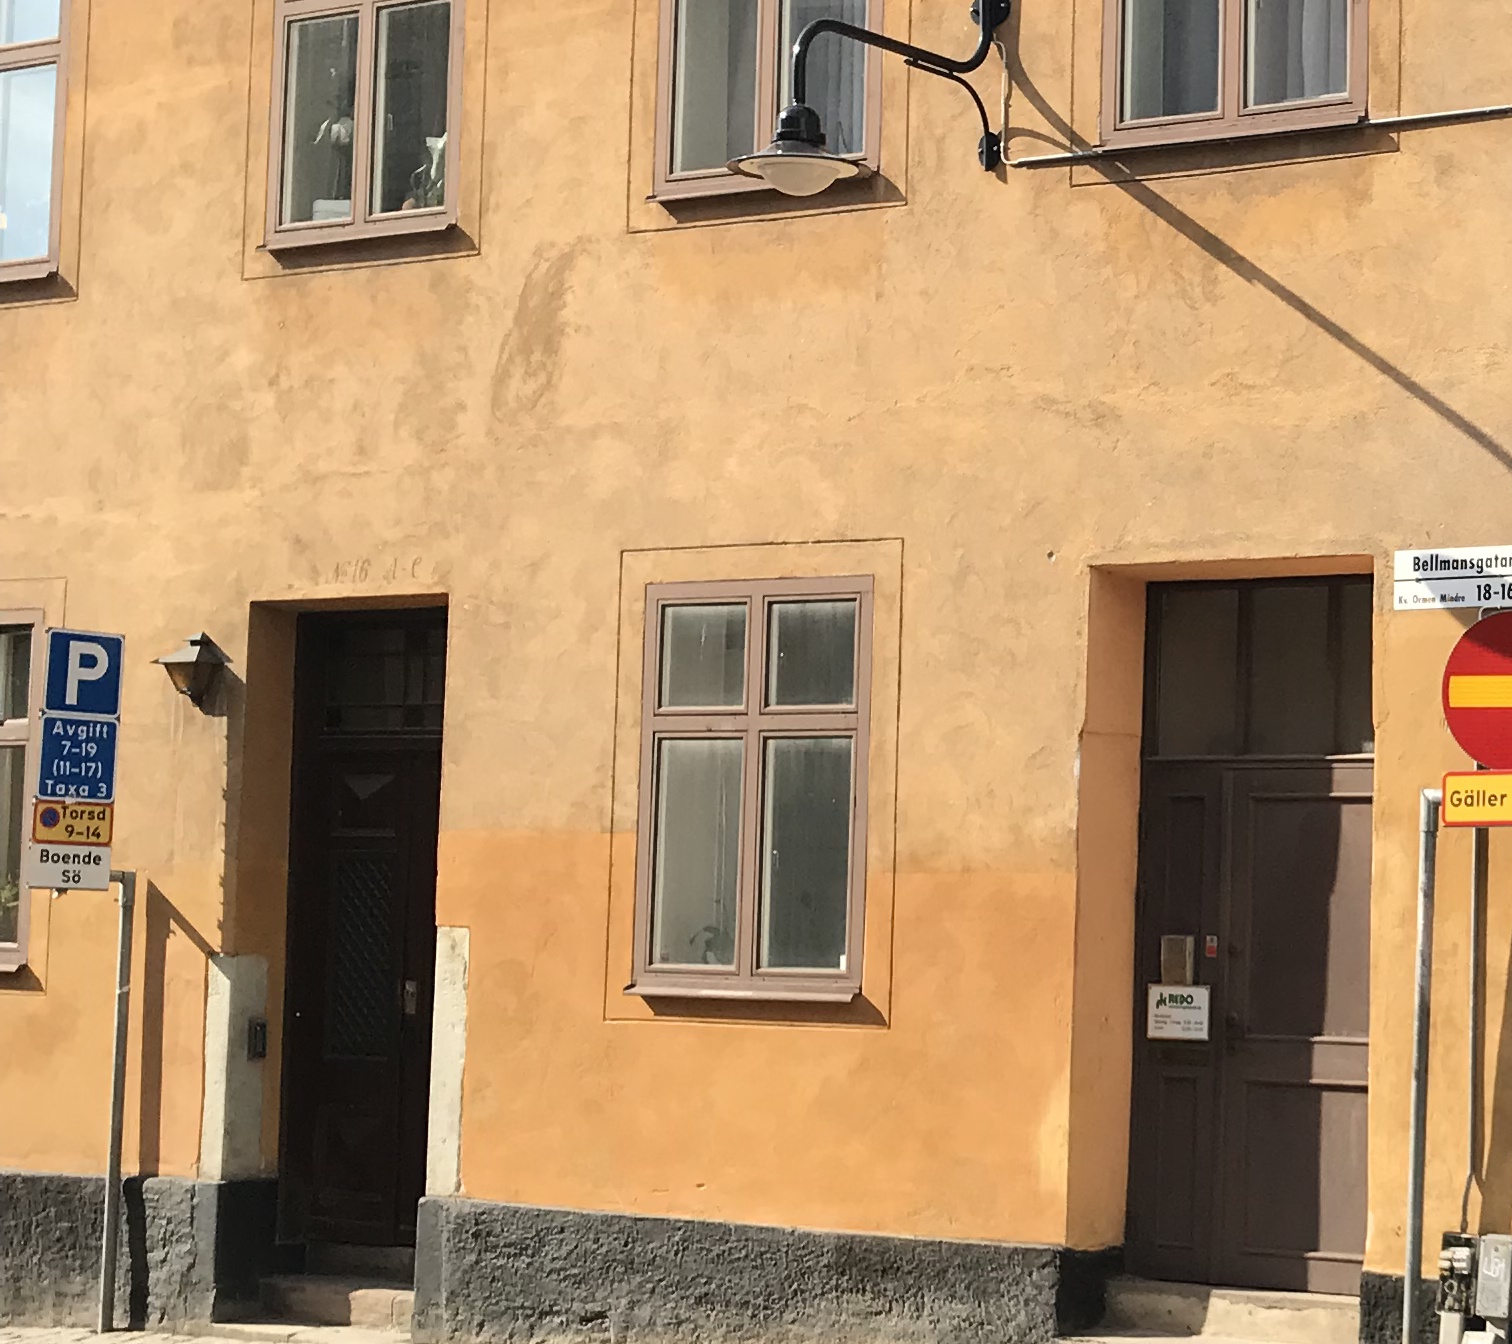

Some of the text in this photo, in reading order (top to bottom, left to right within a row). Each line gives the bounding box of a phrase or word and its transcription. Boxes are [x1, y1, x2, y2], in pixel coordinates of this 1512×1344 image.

[65, 640, 109, 705] P
[52, 720, 108, 740] Avgift
[61, 740, 97, 758] 7-19
[52, 759, 102, 779] (11-17)
[45, 779, 107, 797] Taxa 3
[1450, 789, 1507, 808] Gäller
[61, 805, 106, 821] Torsd
[65, 824, 101, 840] 9-14
[40, 848, 102, 865] Boende
[61, 869, 81, 884] Sö
